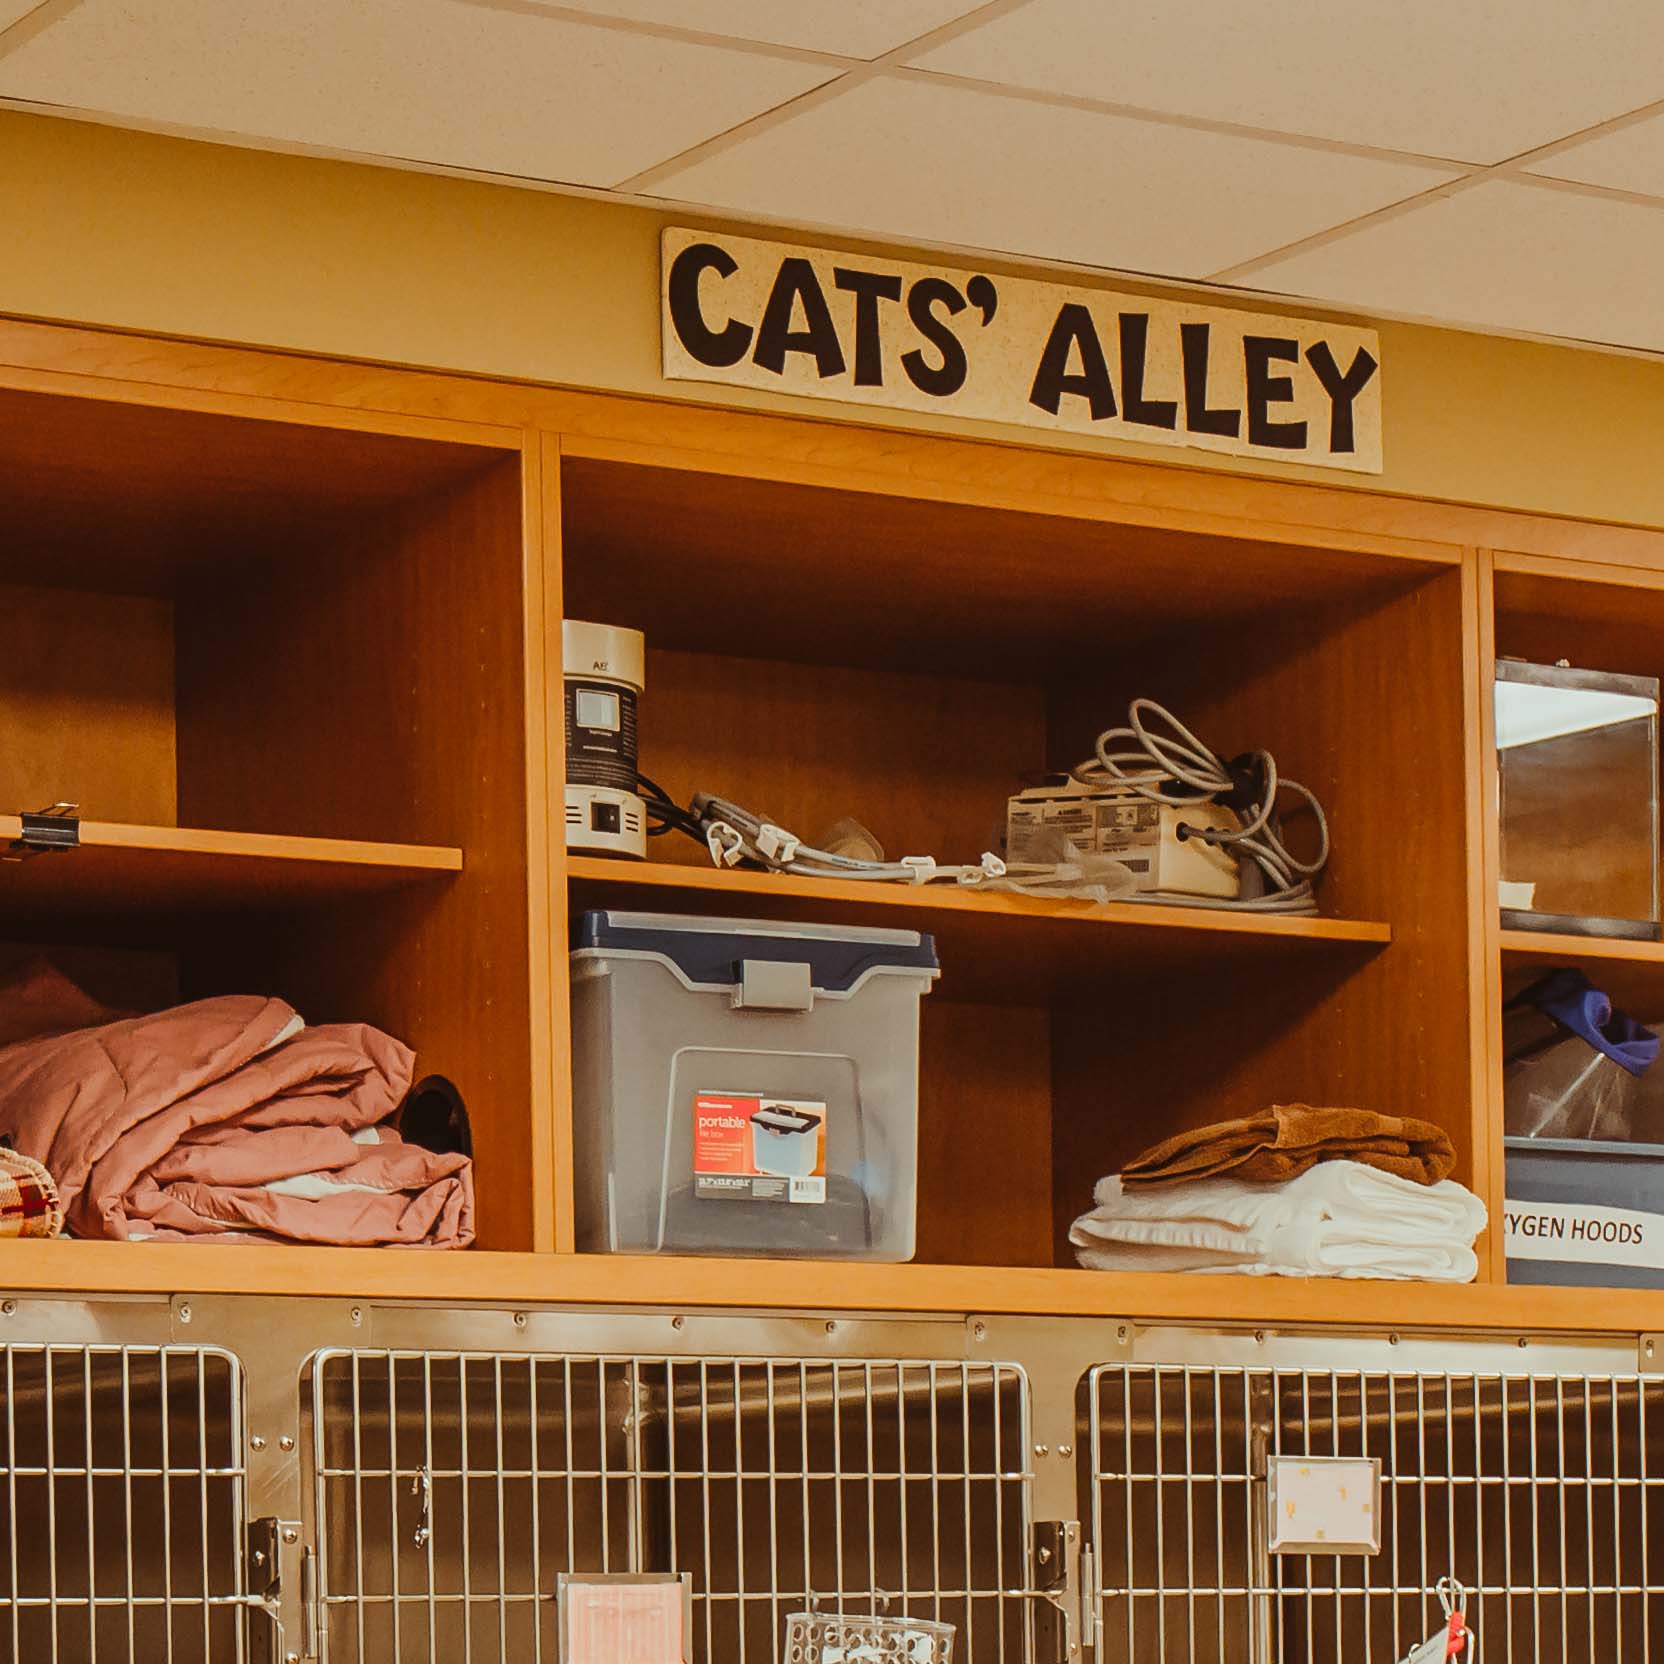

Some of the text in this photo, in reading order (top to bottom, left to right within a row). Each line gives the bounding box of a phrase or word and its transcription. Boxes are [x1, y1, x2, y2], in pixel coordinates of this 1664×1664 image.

[668, 243, 1379, 453] CATS’ ALLEY
[698, 1116, 745, 1128] portable
[1571, 1219, 1643, 1245] HOODS
